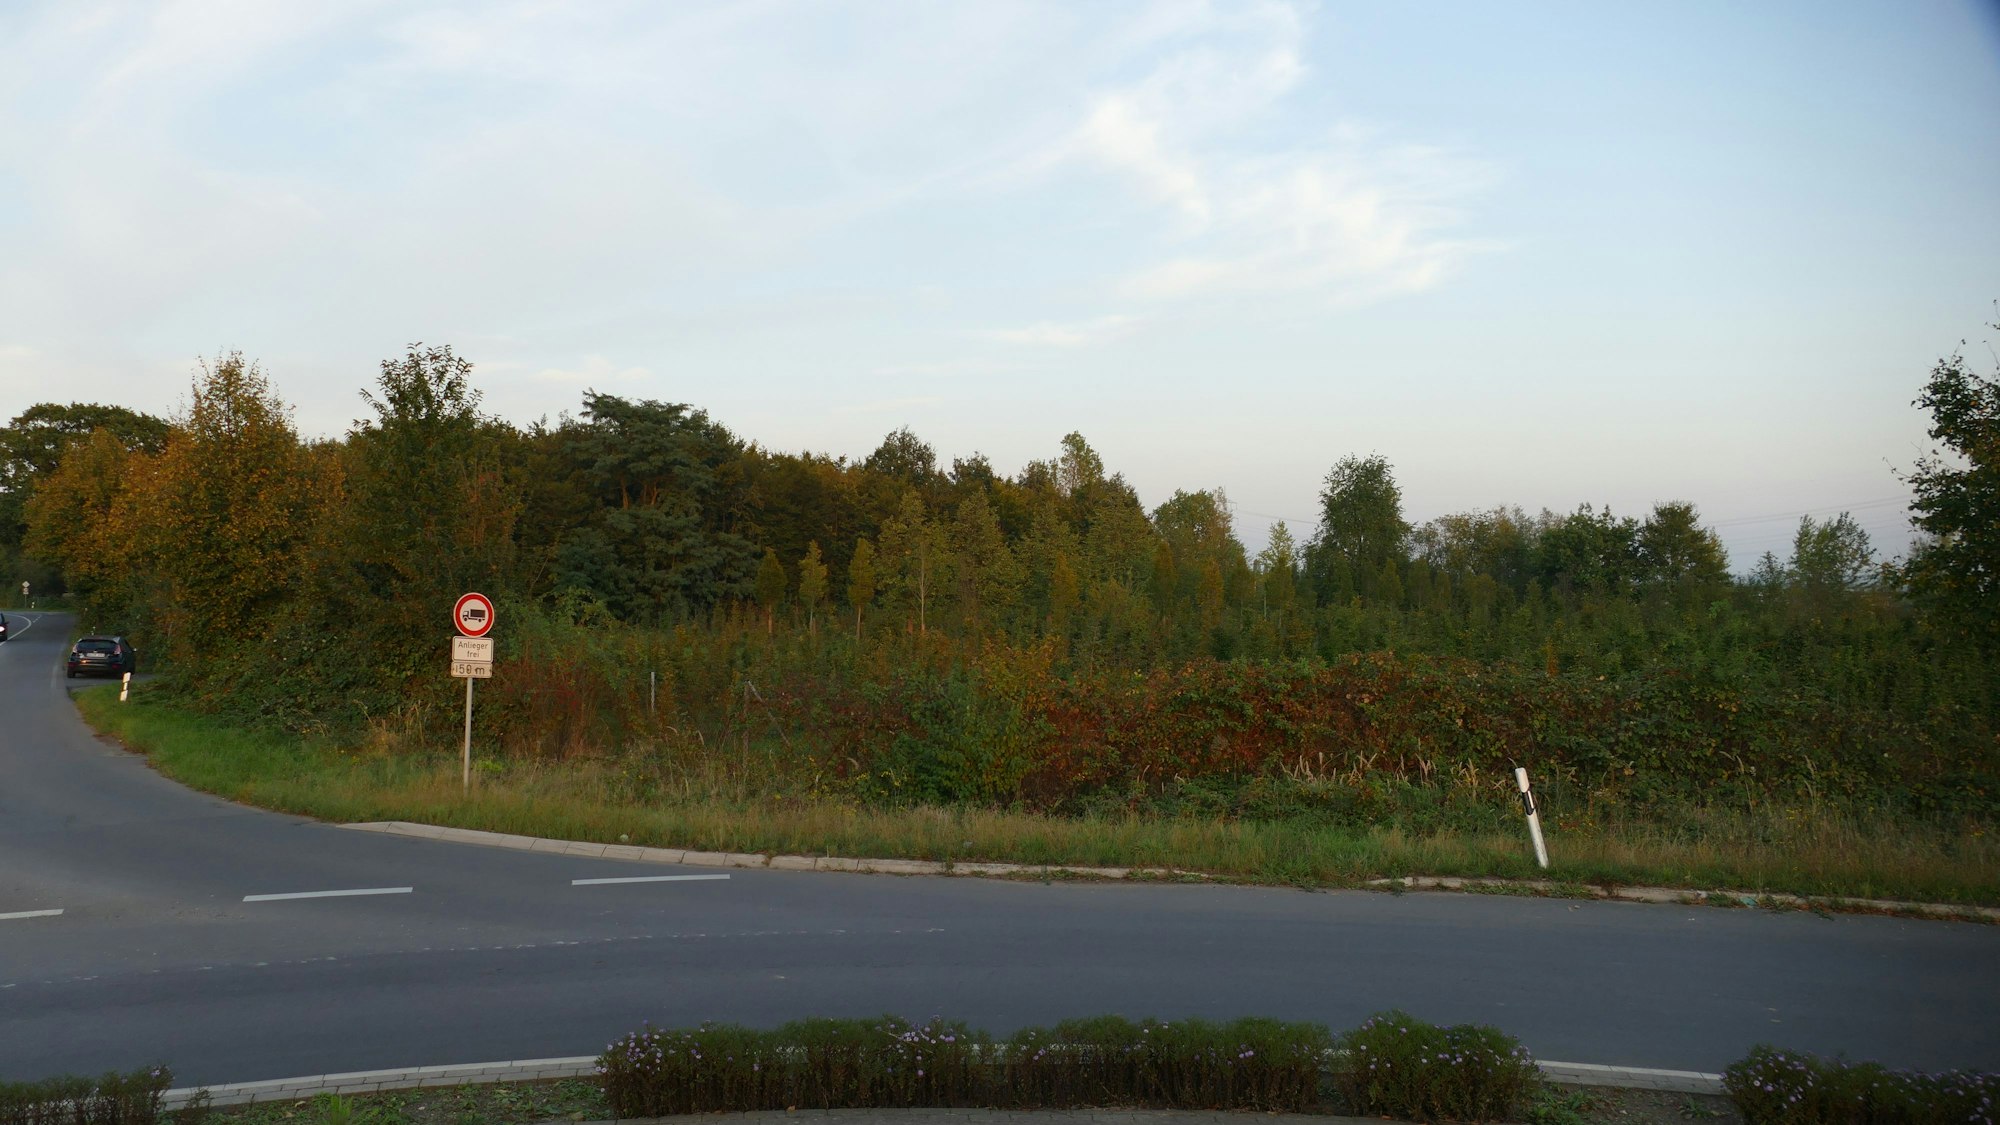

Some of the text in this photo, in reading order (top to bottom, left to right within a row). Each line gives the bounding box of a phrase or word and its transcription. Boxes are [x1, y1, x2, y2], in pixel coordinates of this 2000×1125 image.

[458, 641, 488, 650] Anlieger
[467, 650, 480, 658] frei
[455, 664, 485, 675] 150 m
